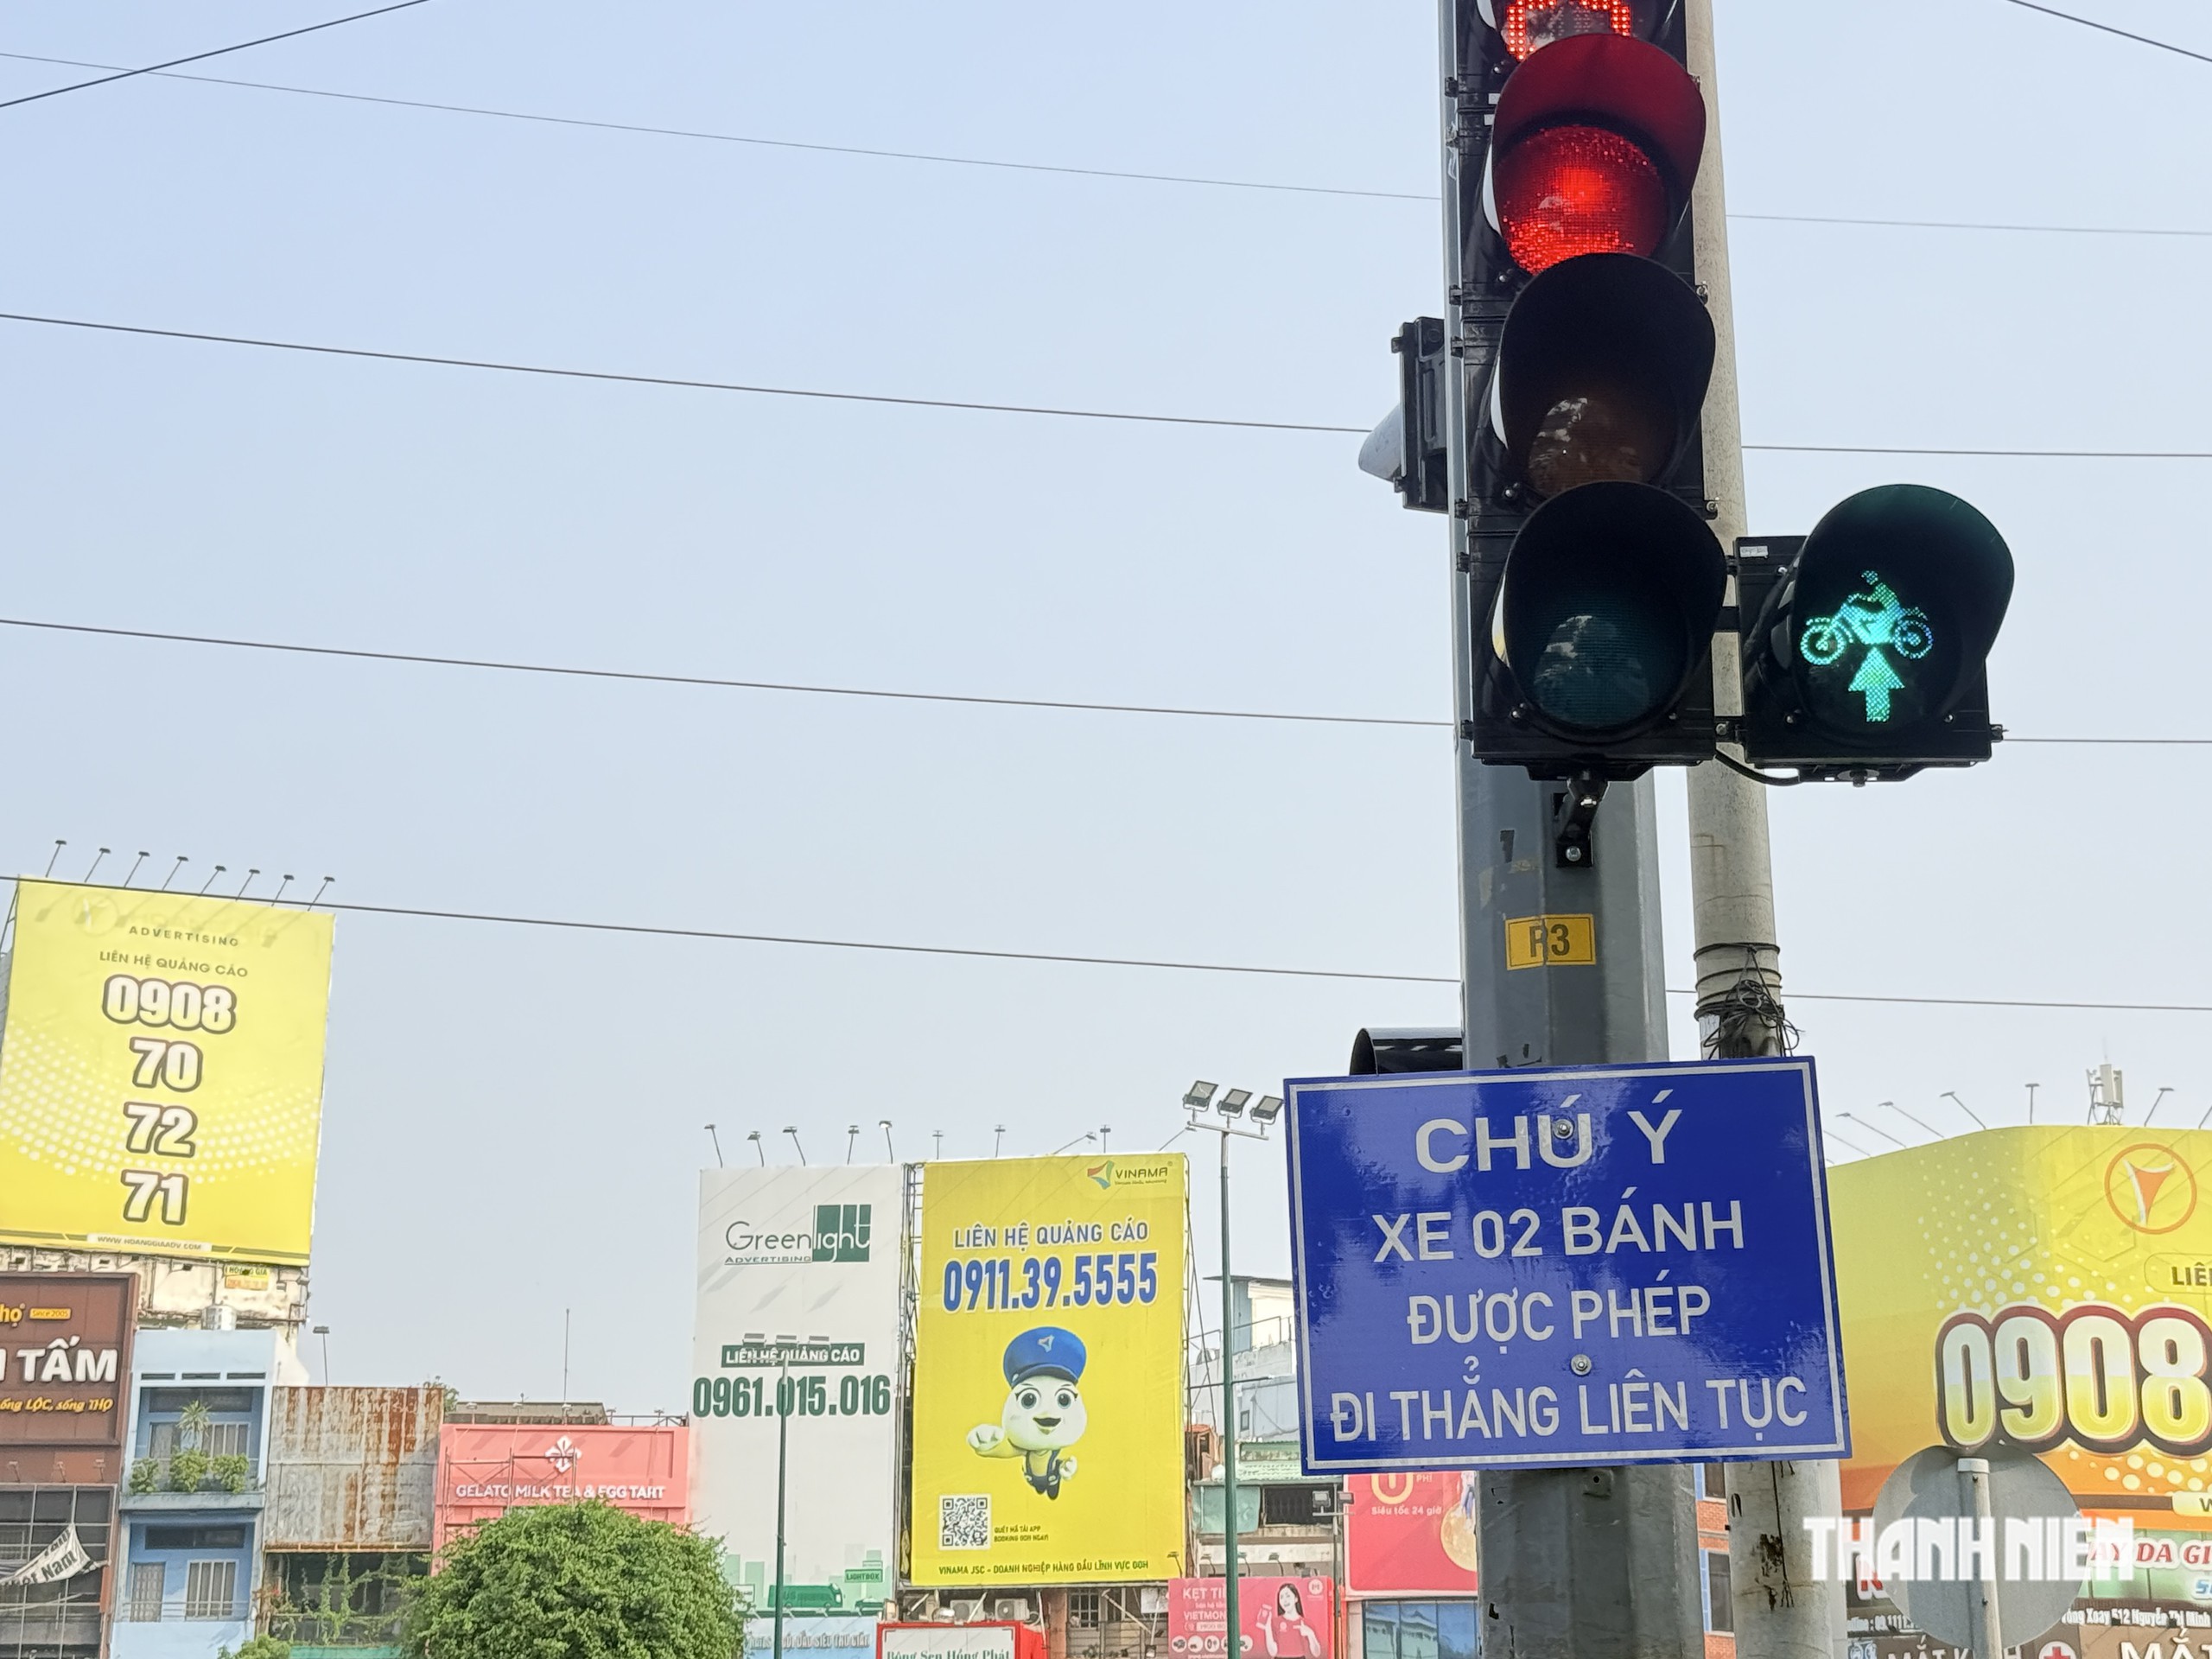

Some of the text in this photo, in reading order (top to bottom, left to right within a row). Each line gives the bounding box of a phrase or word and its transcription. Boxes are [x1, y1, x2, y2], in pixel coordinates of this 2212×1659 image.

[129, 925, 238, 947] ADVERTISING
[1529, 924, 1570, 957] R3
[99, 950, 248, 978] LIÊN HỆ QUẢNG CÁO
[102, 974, 237, 1034] 0908
[130, 1036, 203, 1092] 70
[124, 1102, 197, 1158] 72
[1415, 1089, 1682, 1173] CHÚ Ý
[1116, 1166, 1168, 1179] VINAMA
[120, 1169, 189, 1225] 71
[726, 1205, 871, 1262] Greenlight
[954, 1217, 1147, 1251] LIÊN HỆ QUẢNG CÁO
[1372, 1186, 1744, 1262] XE 02 BÁNH
[944, 1252, 1157, 1312] 0911.39.5555
[1407, 1268, 1711, 1354] ĐƯỢC PHÉP
[16, 1335, 118, 1382] TẤM
[830, 1346, 860, 1362] CÁO
[693, 1374, 891, 1418] 0961.015.016
[1331, 1355, 1808, 1442] ĐI THẲNG LIÊN TỤC
[1936, 1306, 2212, 1457] 0908
[55, 1398, 86, 1414] sống
[456, 1484, 510, 1497] GELATO
[515, 1484, 550, 1498] MILK
[553, 1484, 582, 1498] TEA
[583, 1484, 595, 1498] &
[629, 1484, 666, 1499] TART
[1412, 1506, 1425, 1515] 24
[938, 1566, 969, 1575] VINAMA
[970, 1565, 985, 1574] JSC
[993, 1565, 1020, 1574] DOANH
[2136, 1542, 2173, 1562] DA
[2185, 1611, 2211, 1628] Minh
